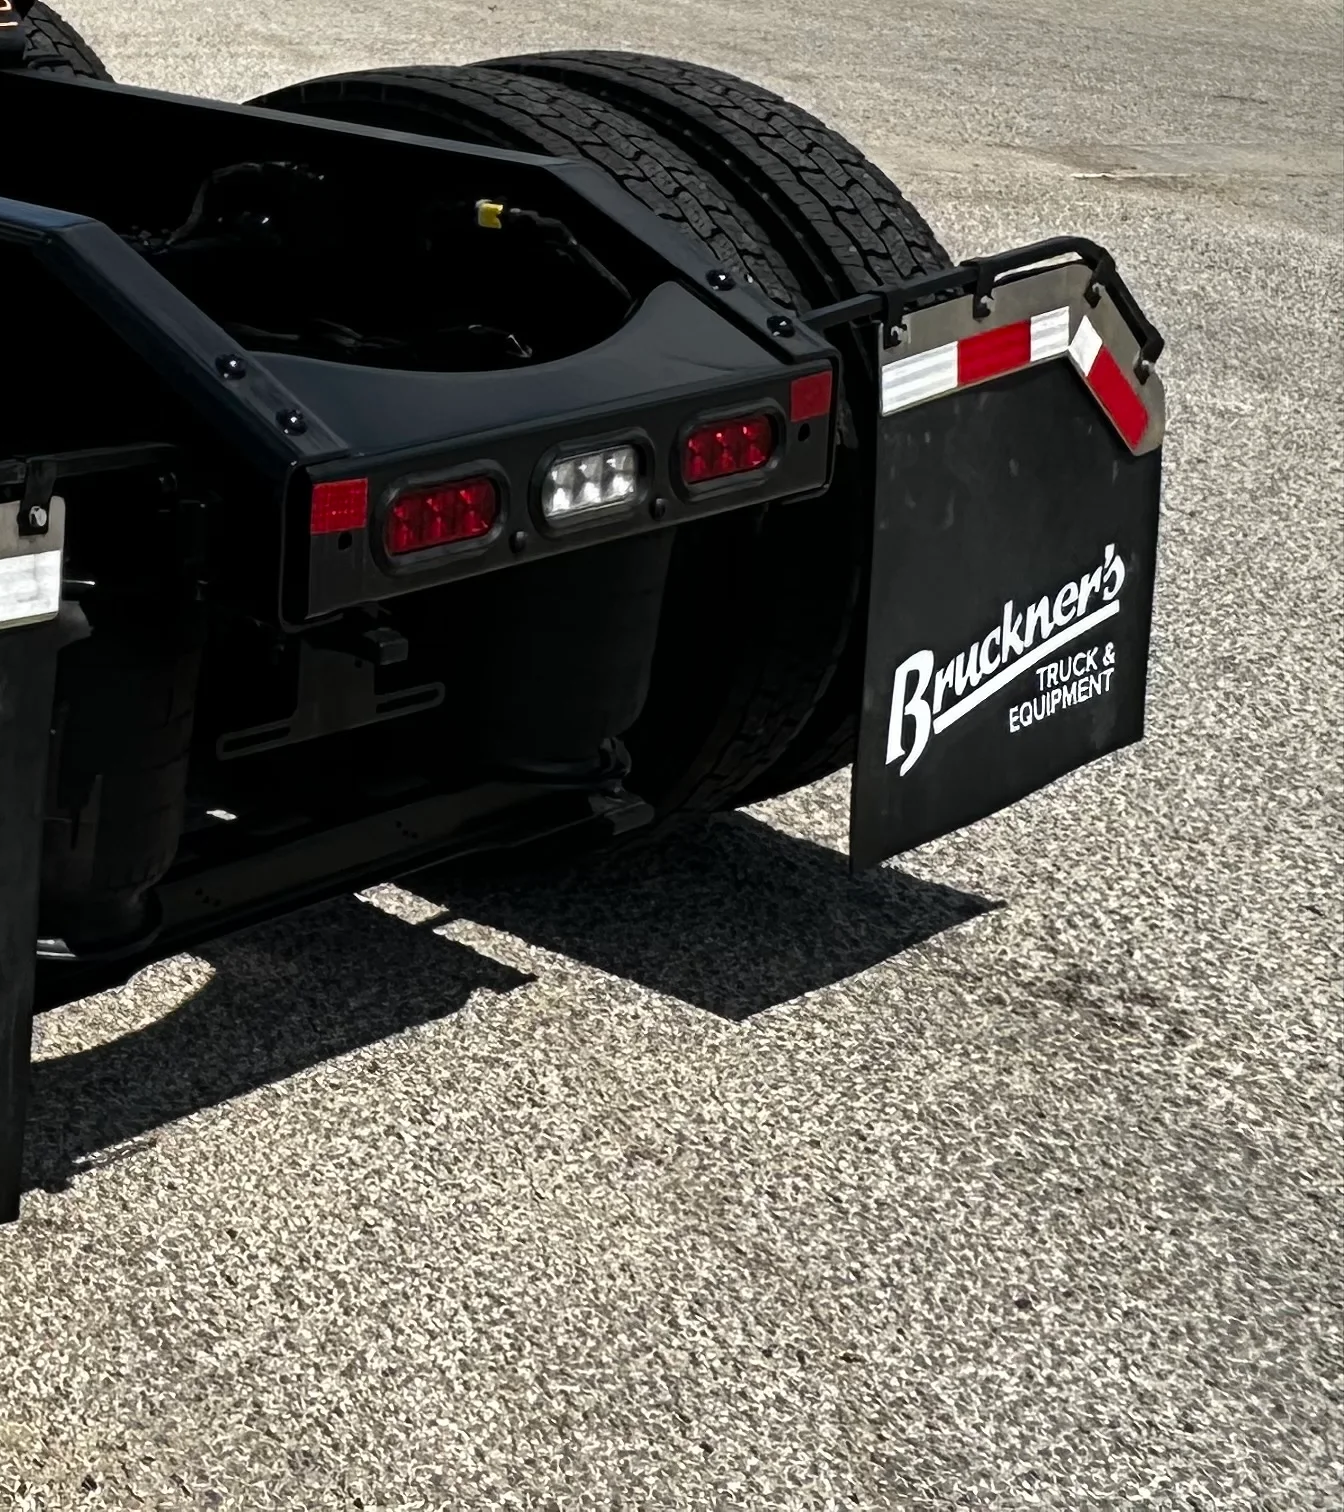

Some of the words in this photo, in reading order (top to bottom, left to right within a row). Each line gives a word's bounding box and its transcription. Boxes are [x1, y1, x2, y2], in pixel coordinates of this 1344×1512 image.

[885, 543, 1126, 777] Bruckner's
[1036, 646, 1099, 692] TRUCK
[1102, 641, 1116, 666] &
[1009, 667, 1116, 734] EQUIPMENT
